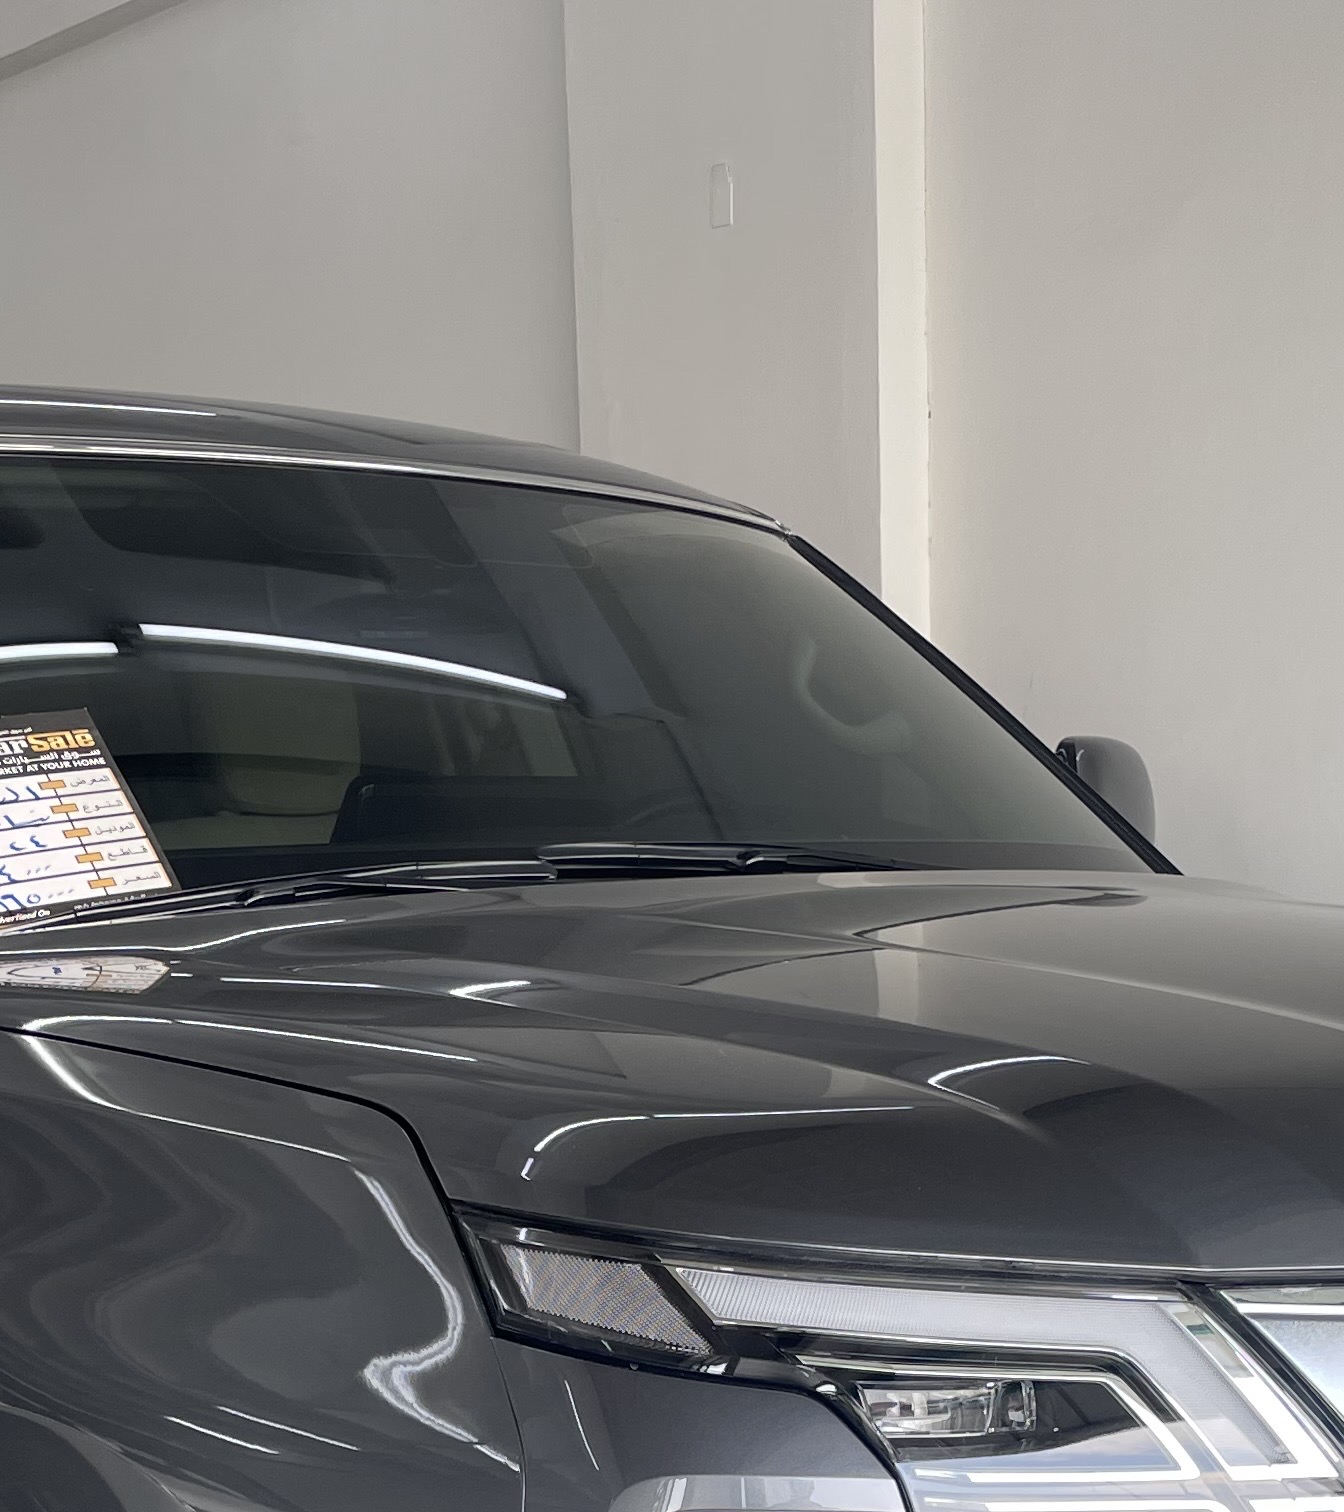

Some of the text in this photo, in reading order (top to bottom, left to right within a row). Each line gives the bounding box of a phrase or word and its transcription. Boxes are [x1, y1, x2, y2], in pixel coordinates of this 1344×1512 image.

[26, 764, 40, 774] AT
[41, 761, 71, 772] YOUR
[72, 757, 107, 768] HOME
[70, 775, 110, 788] المعرض
[83, 799, 123, 814] النوع
[96, 822, 136, 836] الموديل
[108, 845, 149, 861] قاطع
[123, 871, 162, 886] السعر
[37, 909, 51, 918] On
